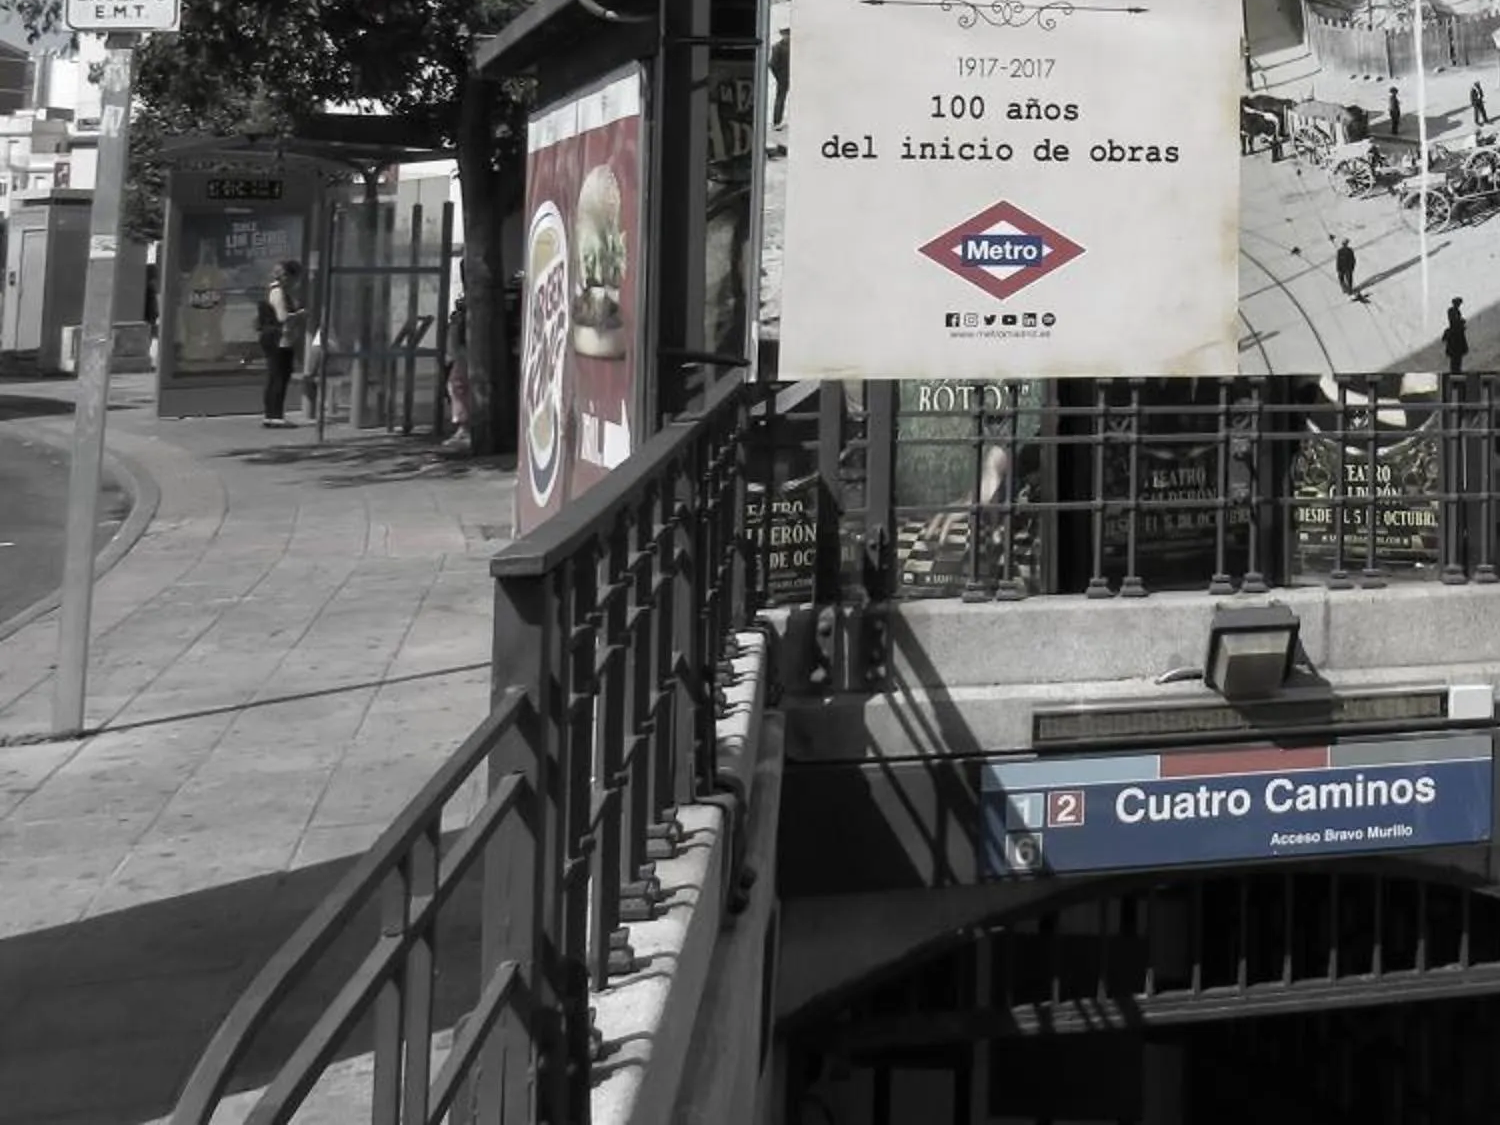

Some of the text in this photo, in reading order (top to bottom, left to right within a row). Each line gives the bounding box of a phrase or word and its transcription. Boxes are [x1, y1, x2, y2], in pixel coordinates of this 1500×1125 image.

[957, 57, 1056, 79] 1917-2017
[931, 95, 1080, 121] 100 años
[821, 136, 1180, 163] del inicio de obras
[967, 240, 1038, 260] Metro
[1056, 794, 1077, 822] 2
[1116, 774, 1436, 824] Cuatro Caminos
[1270, 824, 1413, 846] Acceso Bravo Murillo
[1015, 838, 1034, 865] 6
